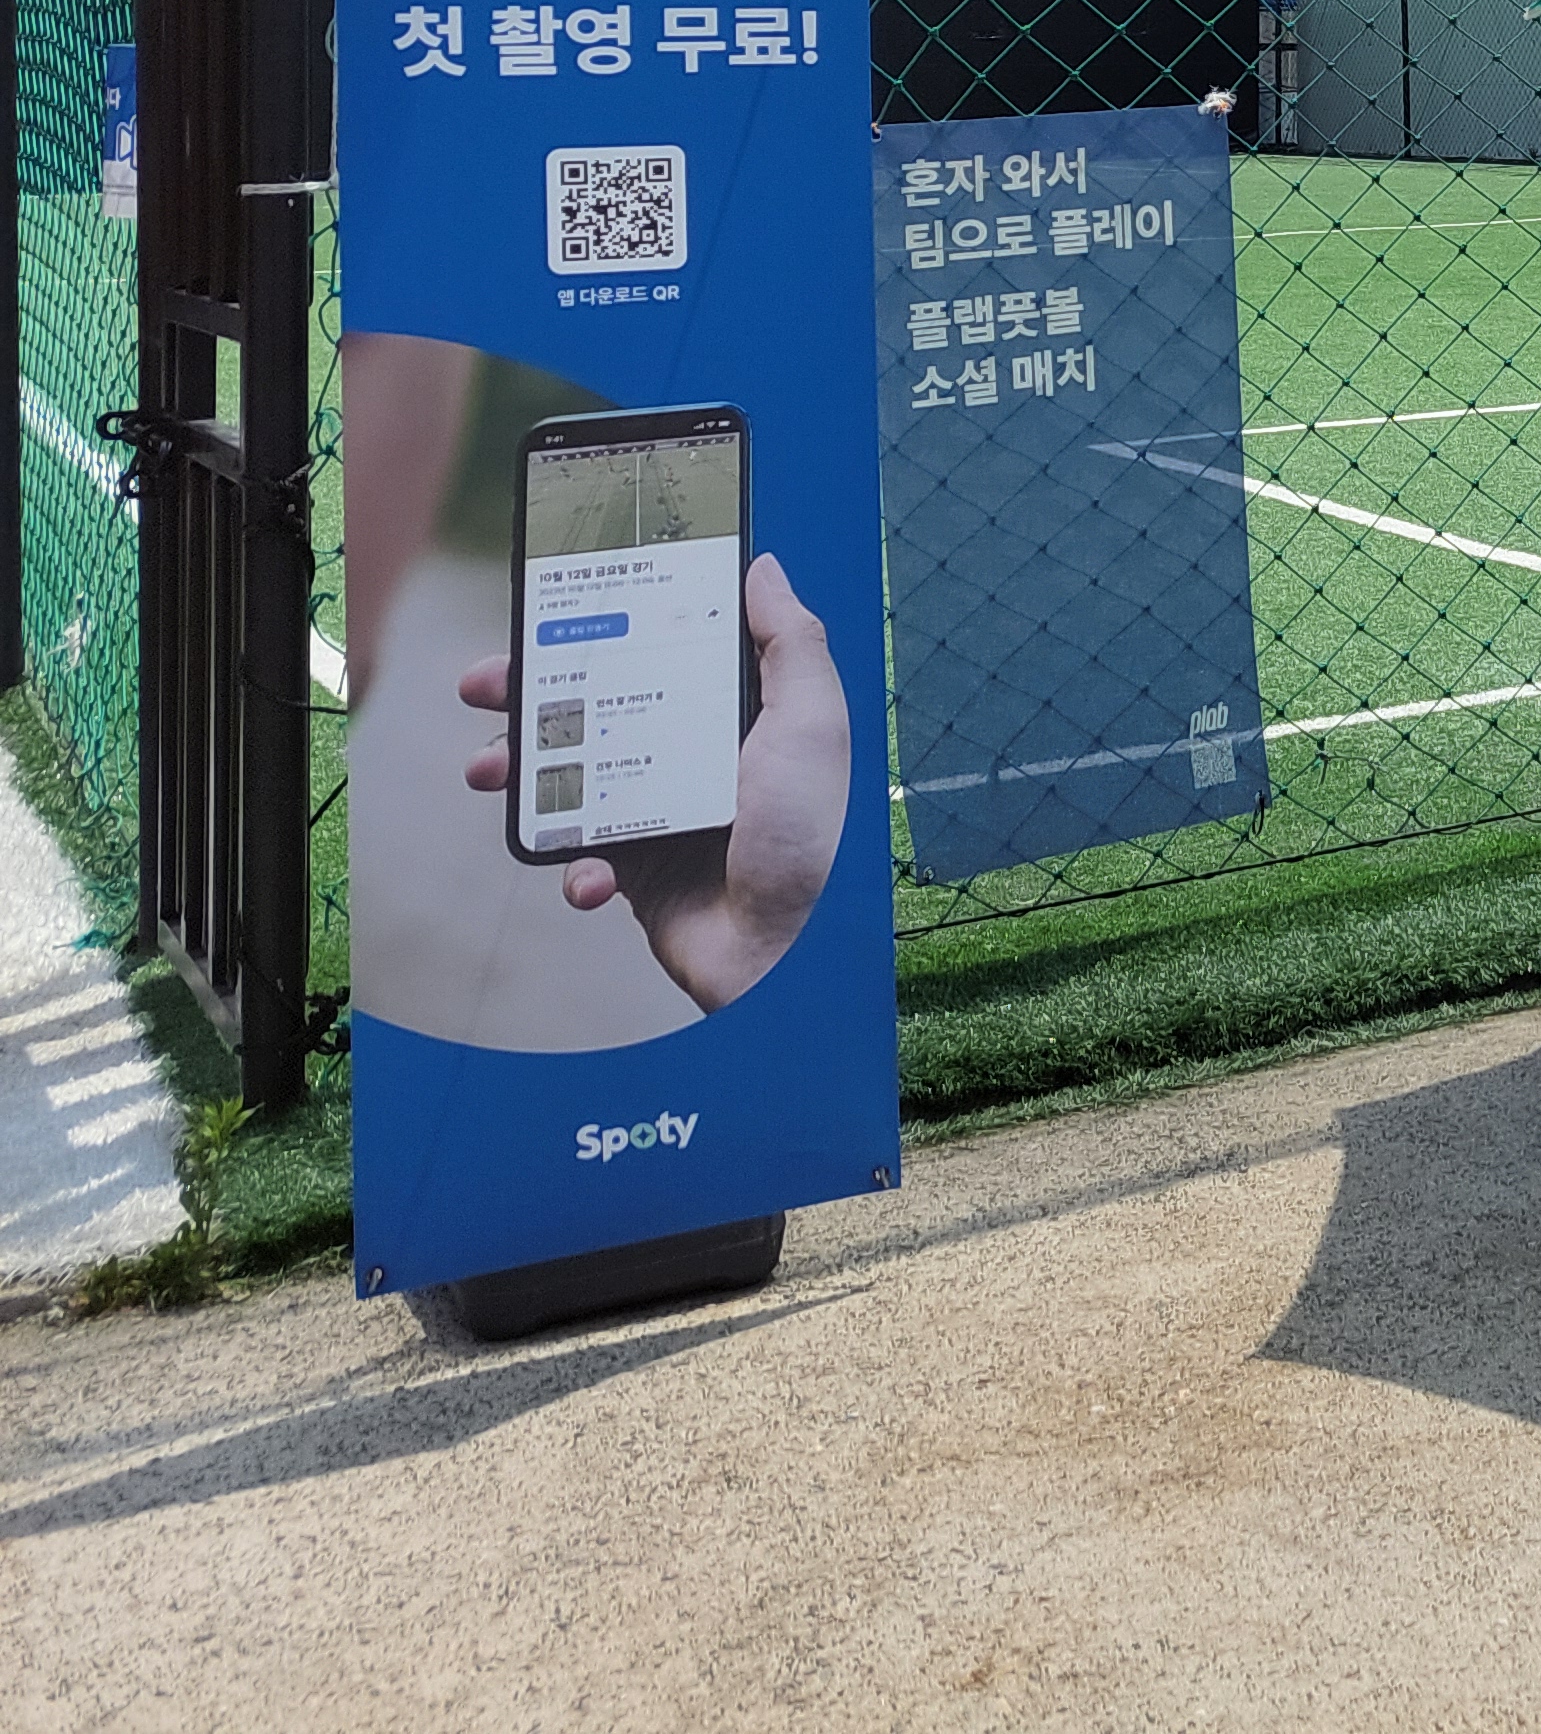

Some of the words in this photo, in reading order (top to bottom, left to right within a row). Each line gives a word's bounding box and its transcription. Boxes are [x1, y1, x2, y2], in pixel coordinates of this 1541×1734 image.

[392, 4, 468, 78] 첫
[489, 4, 632, 77] 촬영
[655, 6, 819, 74] 무료!
[900, 153, 991, 208] 혼자
[1000, 146, 1088, 199] 와서
[904, 213, 1038, 271] 팀으로
[1047, 198, 1175, 257] 플레이
[556, 288, 575, 308] 앱
[578, 285, 649, 306] 다운로드
[651, 284, 681, 302] QR
[905, 285, 1086, 352] 플랩풋볼
[910, 355, 1000, 410] 소셜
[1010, 344, 1097, 398] 매치
[575, 1110, 700, 1163] Spoty
